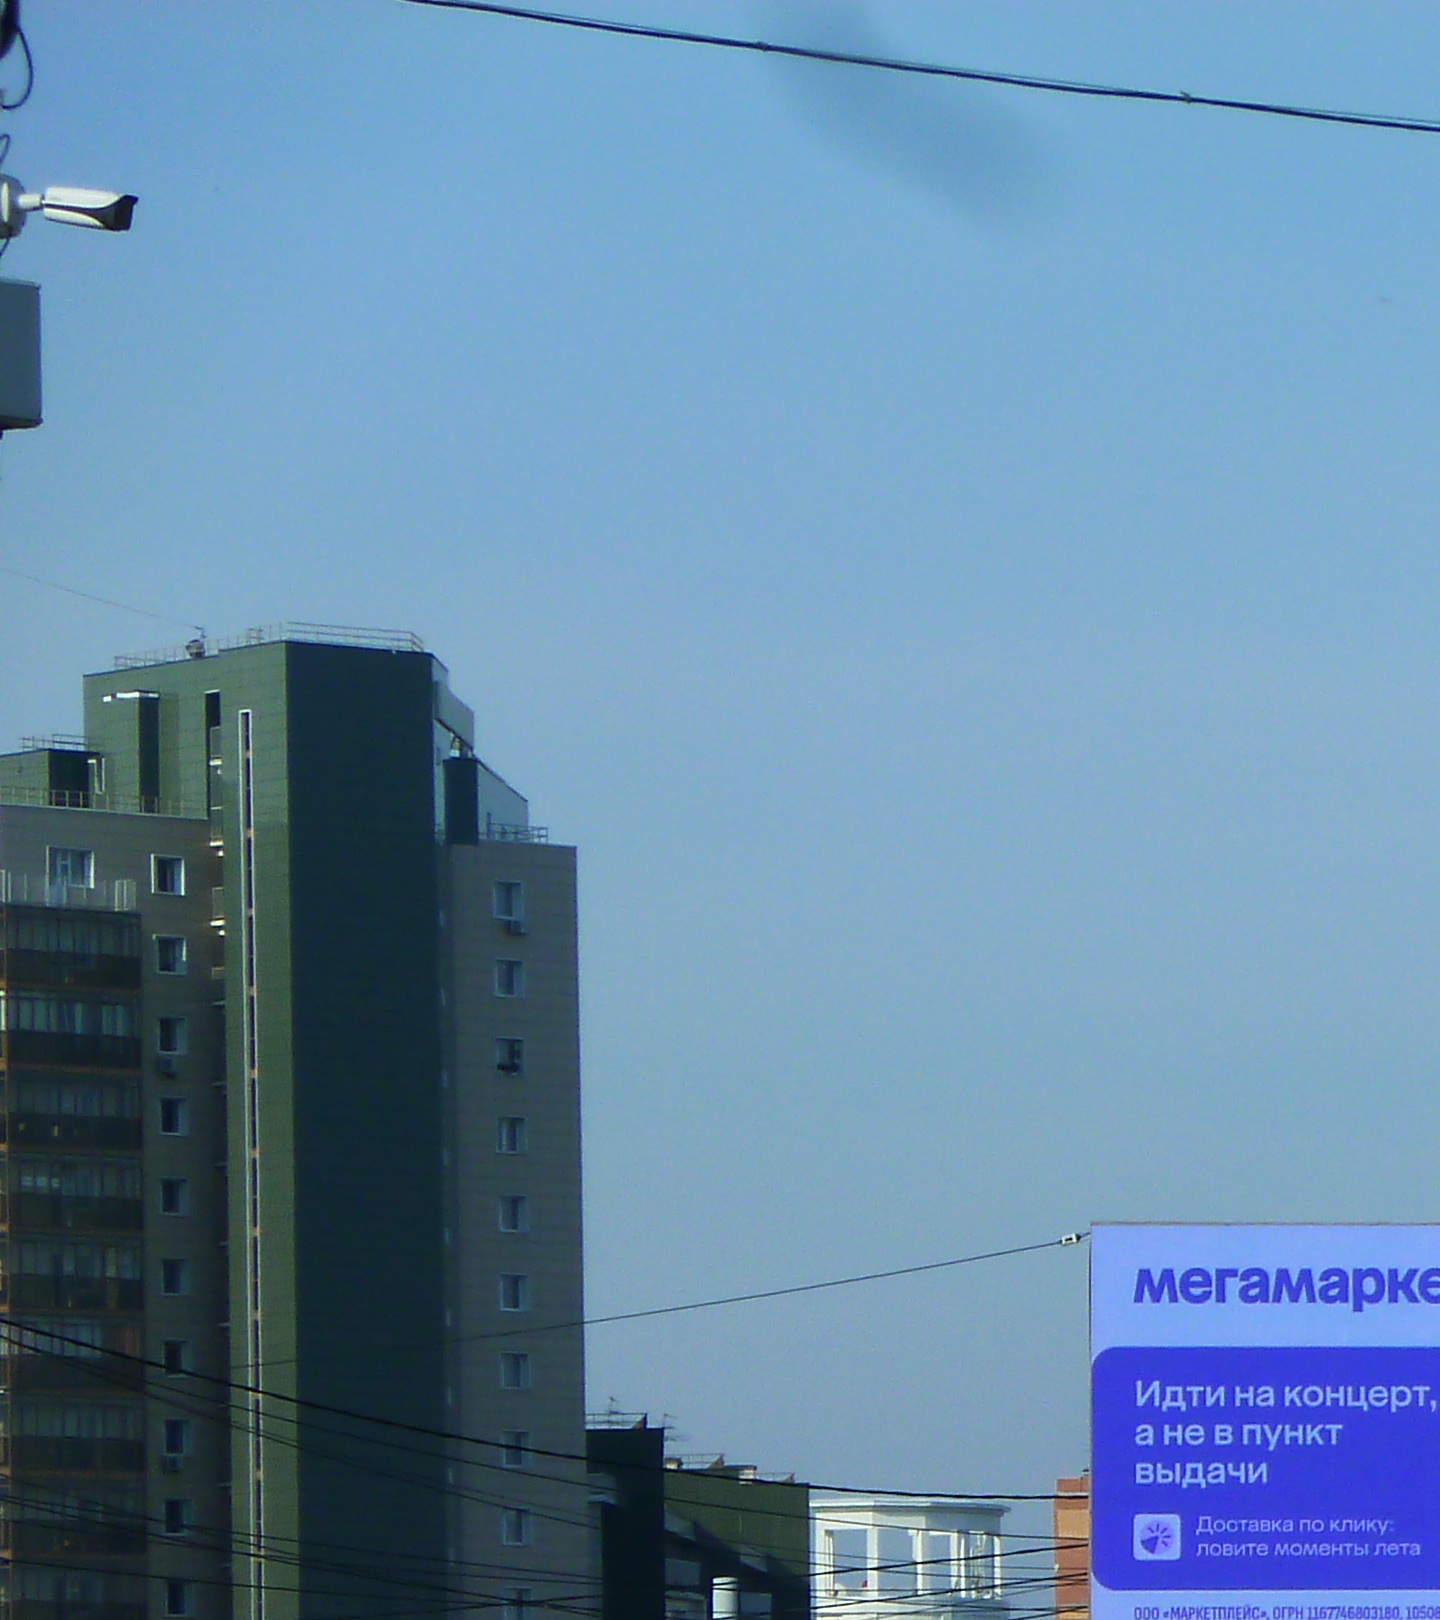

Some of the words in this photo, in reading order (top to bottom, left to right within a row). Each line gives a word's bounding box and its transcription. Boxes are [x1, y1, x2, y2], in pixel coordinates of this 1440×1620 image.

[1135, 1380, 1226, 1412] Идти
[1235, 1385, 1275, 1407] на
[1284, 1384, 1438, 1412] концерт,
[1135, 1423, 1154, 1446] а
[1164, 1424, 1205, 1446] не
[1214, 1424, 1234, 1446] в
[1242, 1423, 1343, 1452] пункт
[1135, 1462, 1268, 1490] выдачи
[1196, 1515, 1294, 1536] Доставка
[1300, 1519, 1325, 1533] по
[1330, 1519, 1396, 1536] клику:
[1196, 1542, 1270, 1557] ловите
[1274, 1542, 1369, 1557] моменты
[1373, 1542, 1421, 1557] лета
[1134, 1606, 1160, 1620] ООО
[1272, 1606, 1304, 1620] ОГРН
